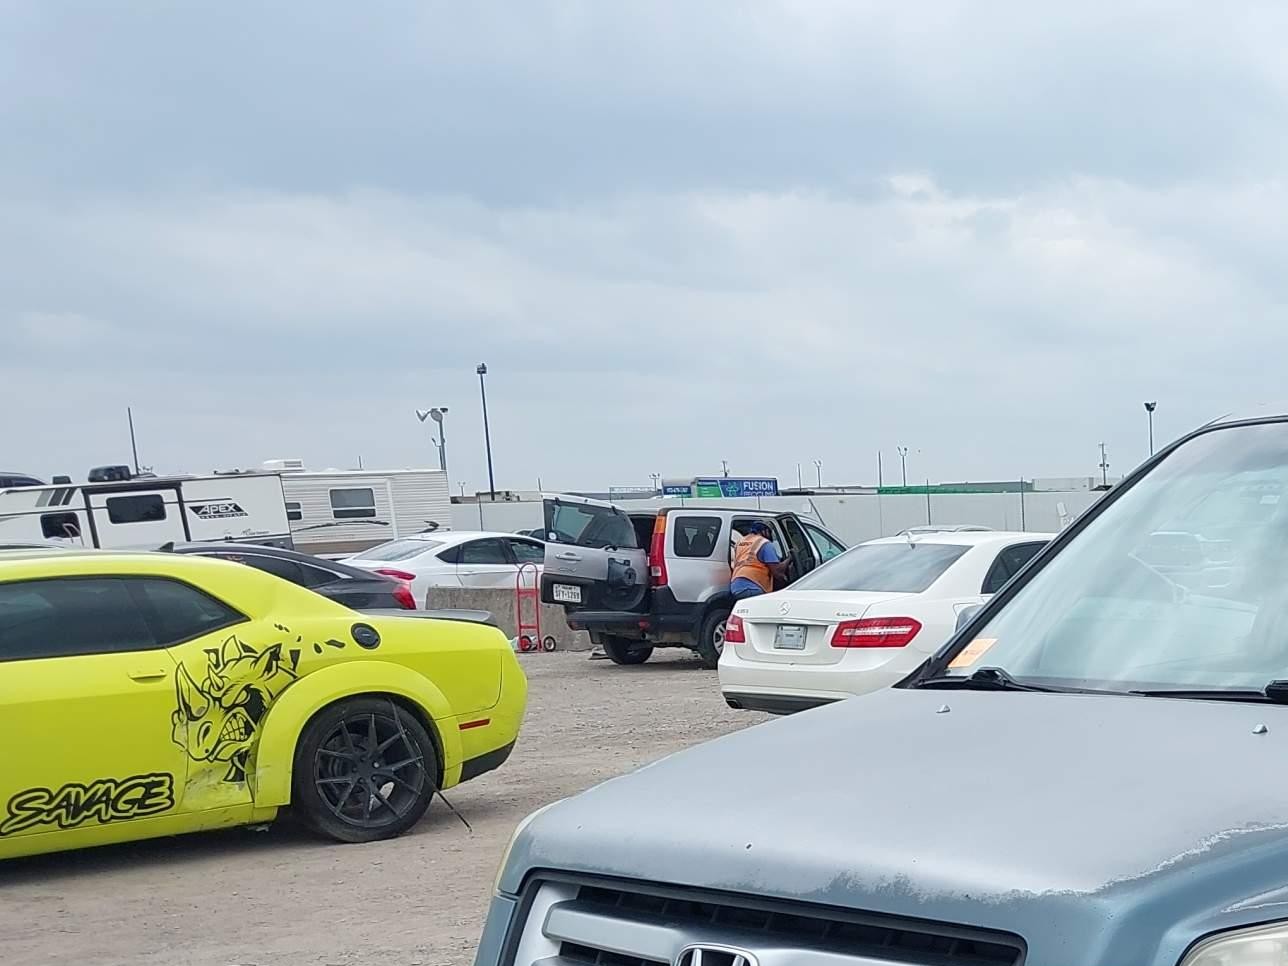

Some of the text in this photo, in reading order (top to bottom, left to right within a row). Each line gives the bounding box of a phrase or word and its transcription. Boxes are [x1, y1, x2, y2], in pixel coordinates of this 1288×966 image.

[743, 481, 774, 491] FUSION
[198, 503, 237, 515] APEX
[0, 772, 175, 836] SAVAGE
